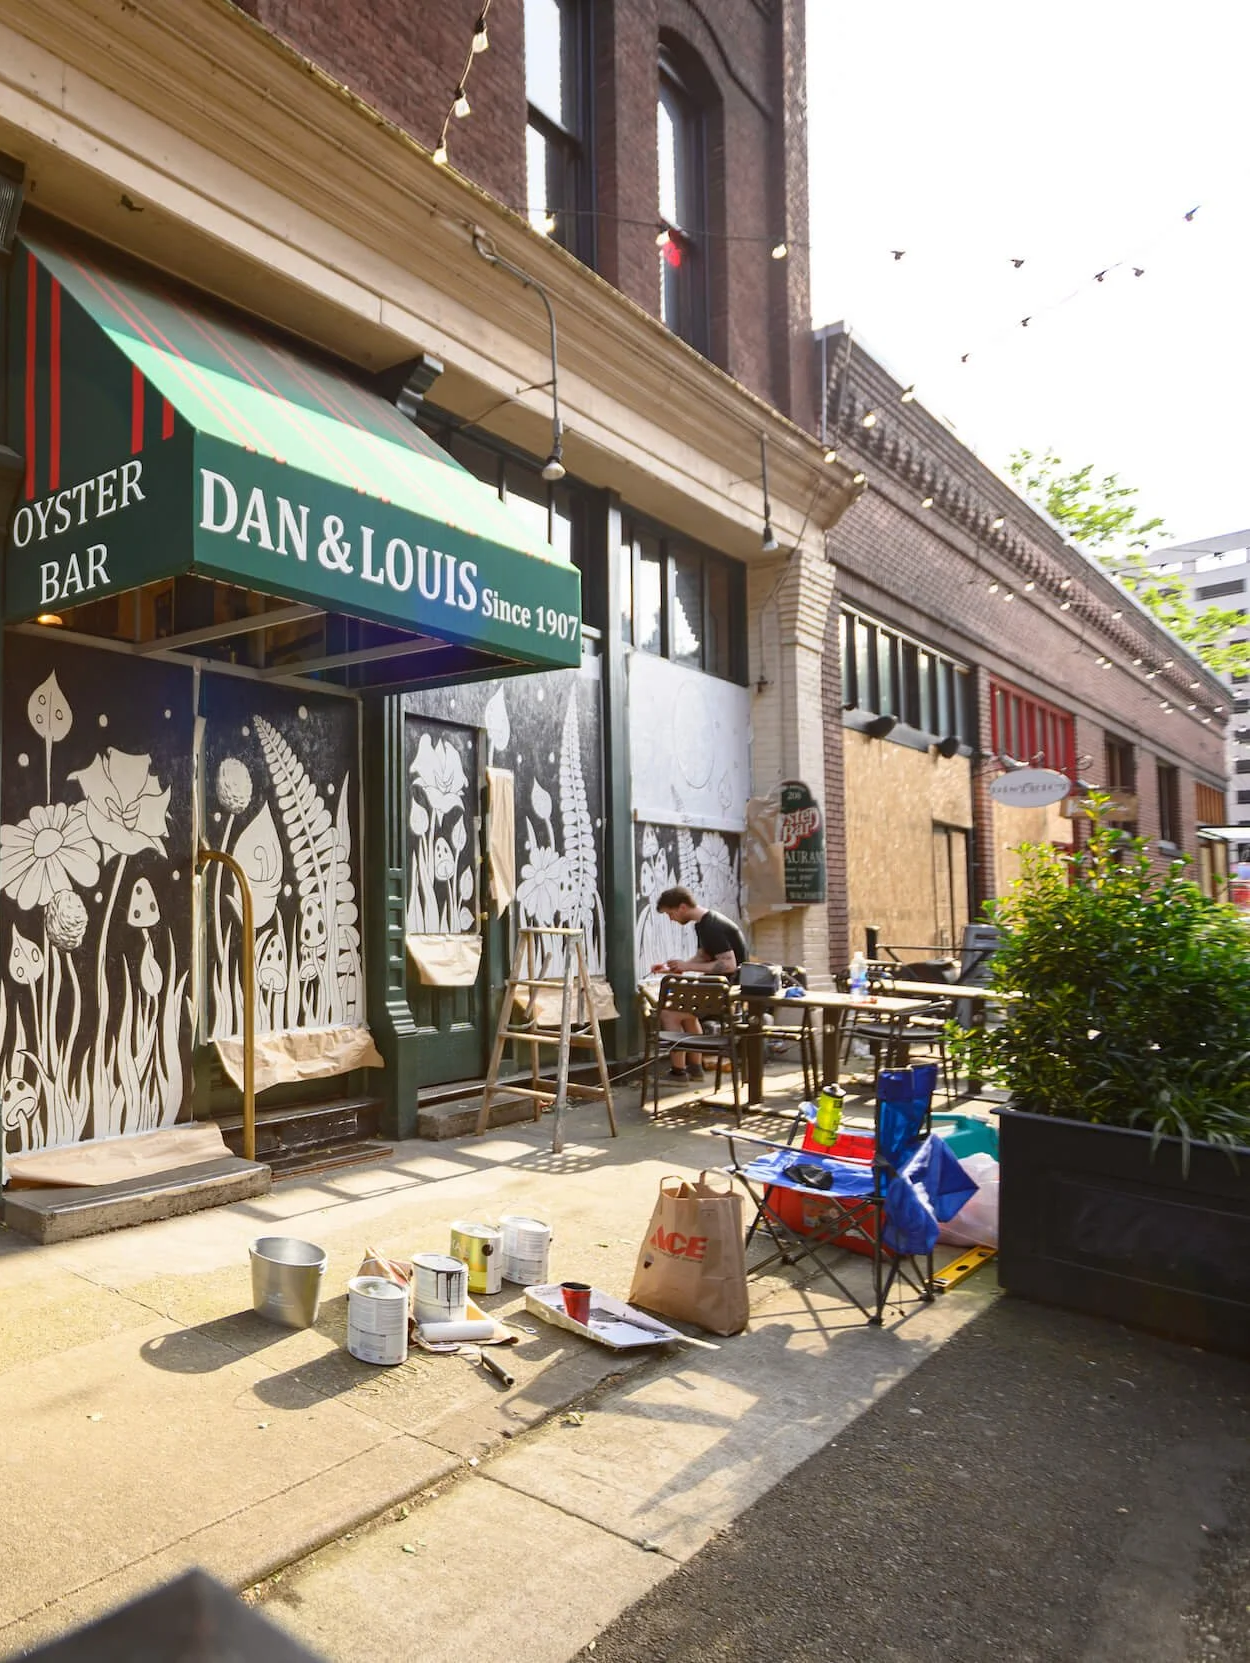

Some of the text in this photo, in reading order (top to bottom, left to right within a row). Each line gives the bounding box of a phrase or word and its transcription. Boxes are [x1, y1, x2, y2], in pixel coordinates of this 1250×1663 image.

[13, 459, 146, 547] OYSTER
[199, 467, 478, 611] DAN & LOUIS
[40, 543, 111, 605] BAR
[481, 587, 579, 641] Since 1907
[648, 1225, 709, 1261] ACE
